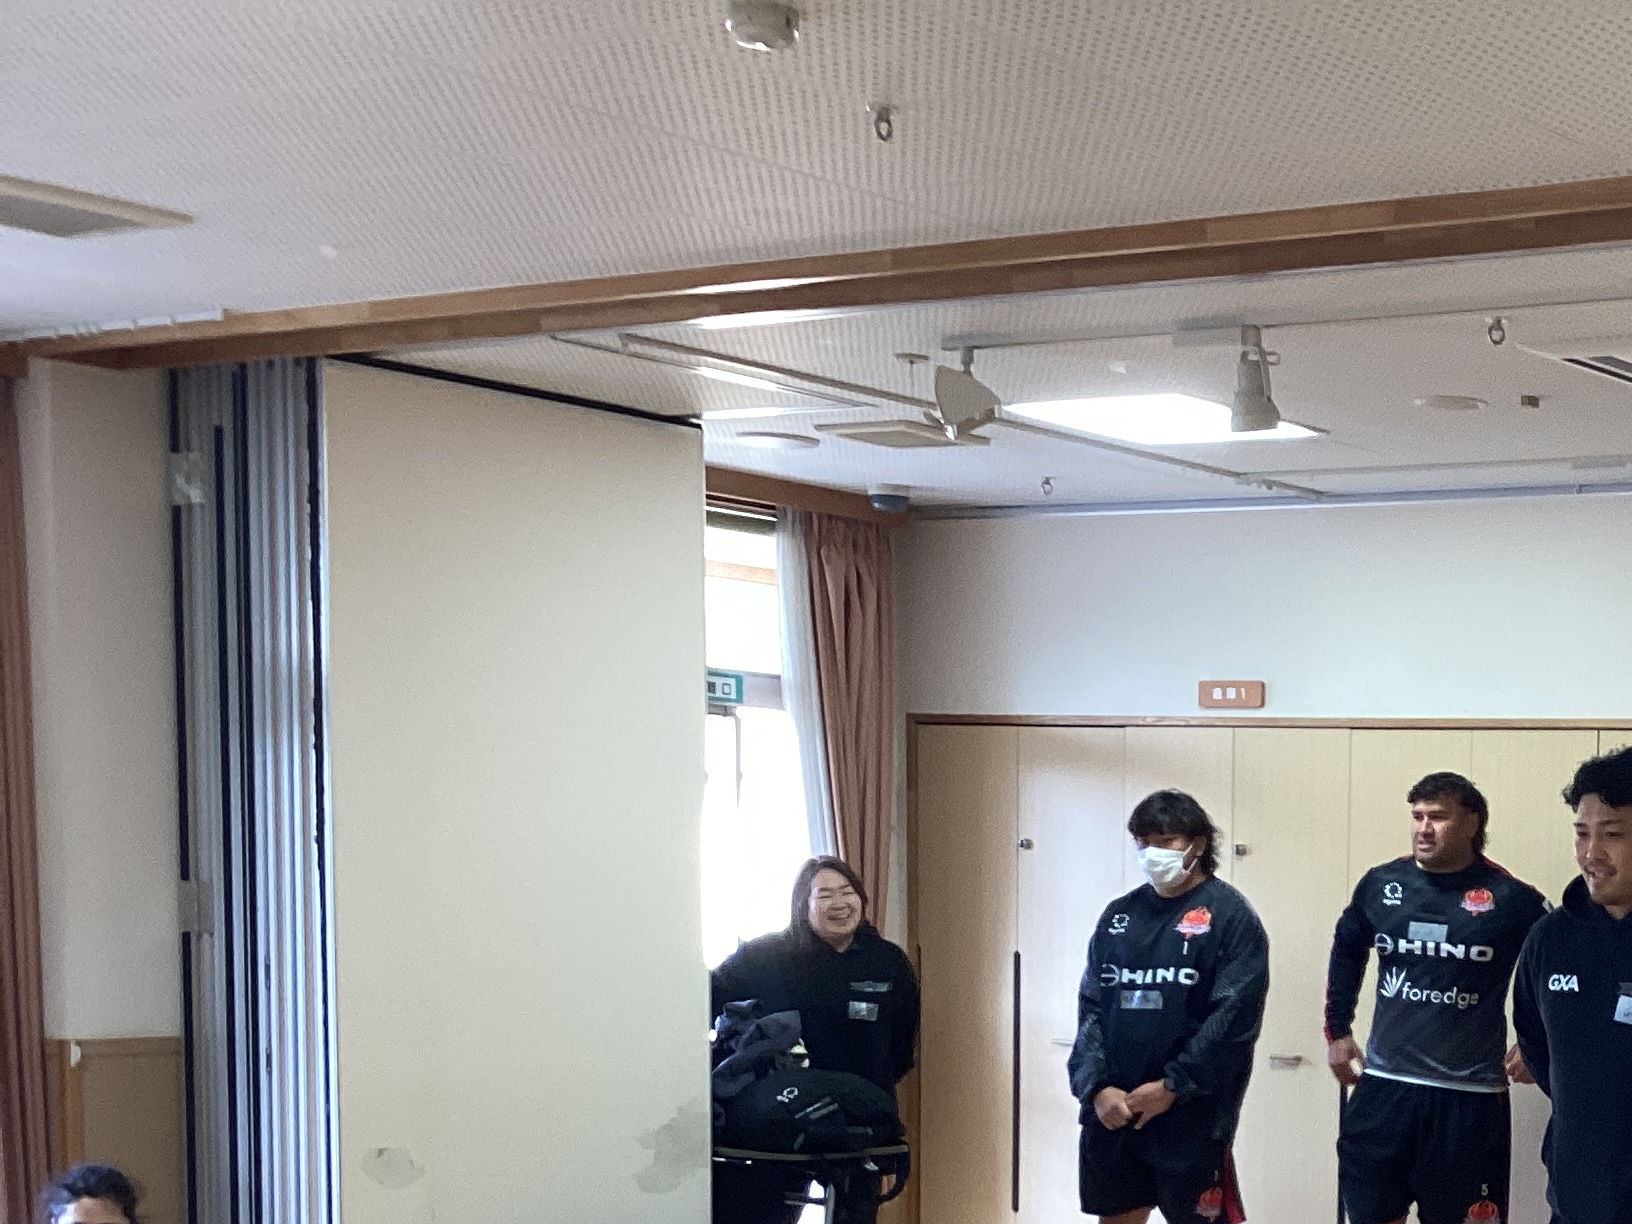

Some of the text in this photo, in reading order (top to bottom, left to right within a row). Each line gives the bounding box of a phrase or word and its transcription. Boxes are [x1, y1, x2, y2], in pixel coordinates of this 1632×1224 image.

[1398, 938, 1494, 962] HINO
[1121, 967, 1199, 985] HINO
[1549, 974, 1579, 992] GXA
[1481, 1183, 1488, 1196] 5
